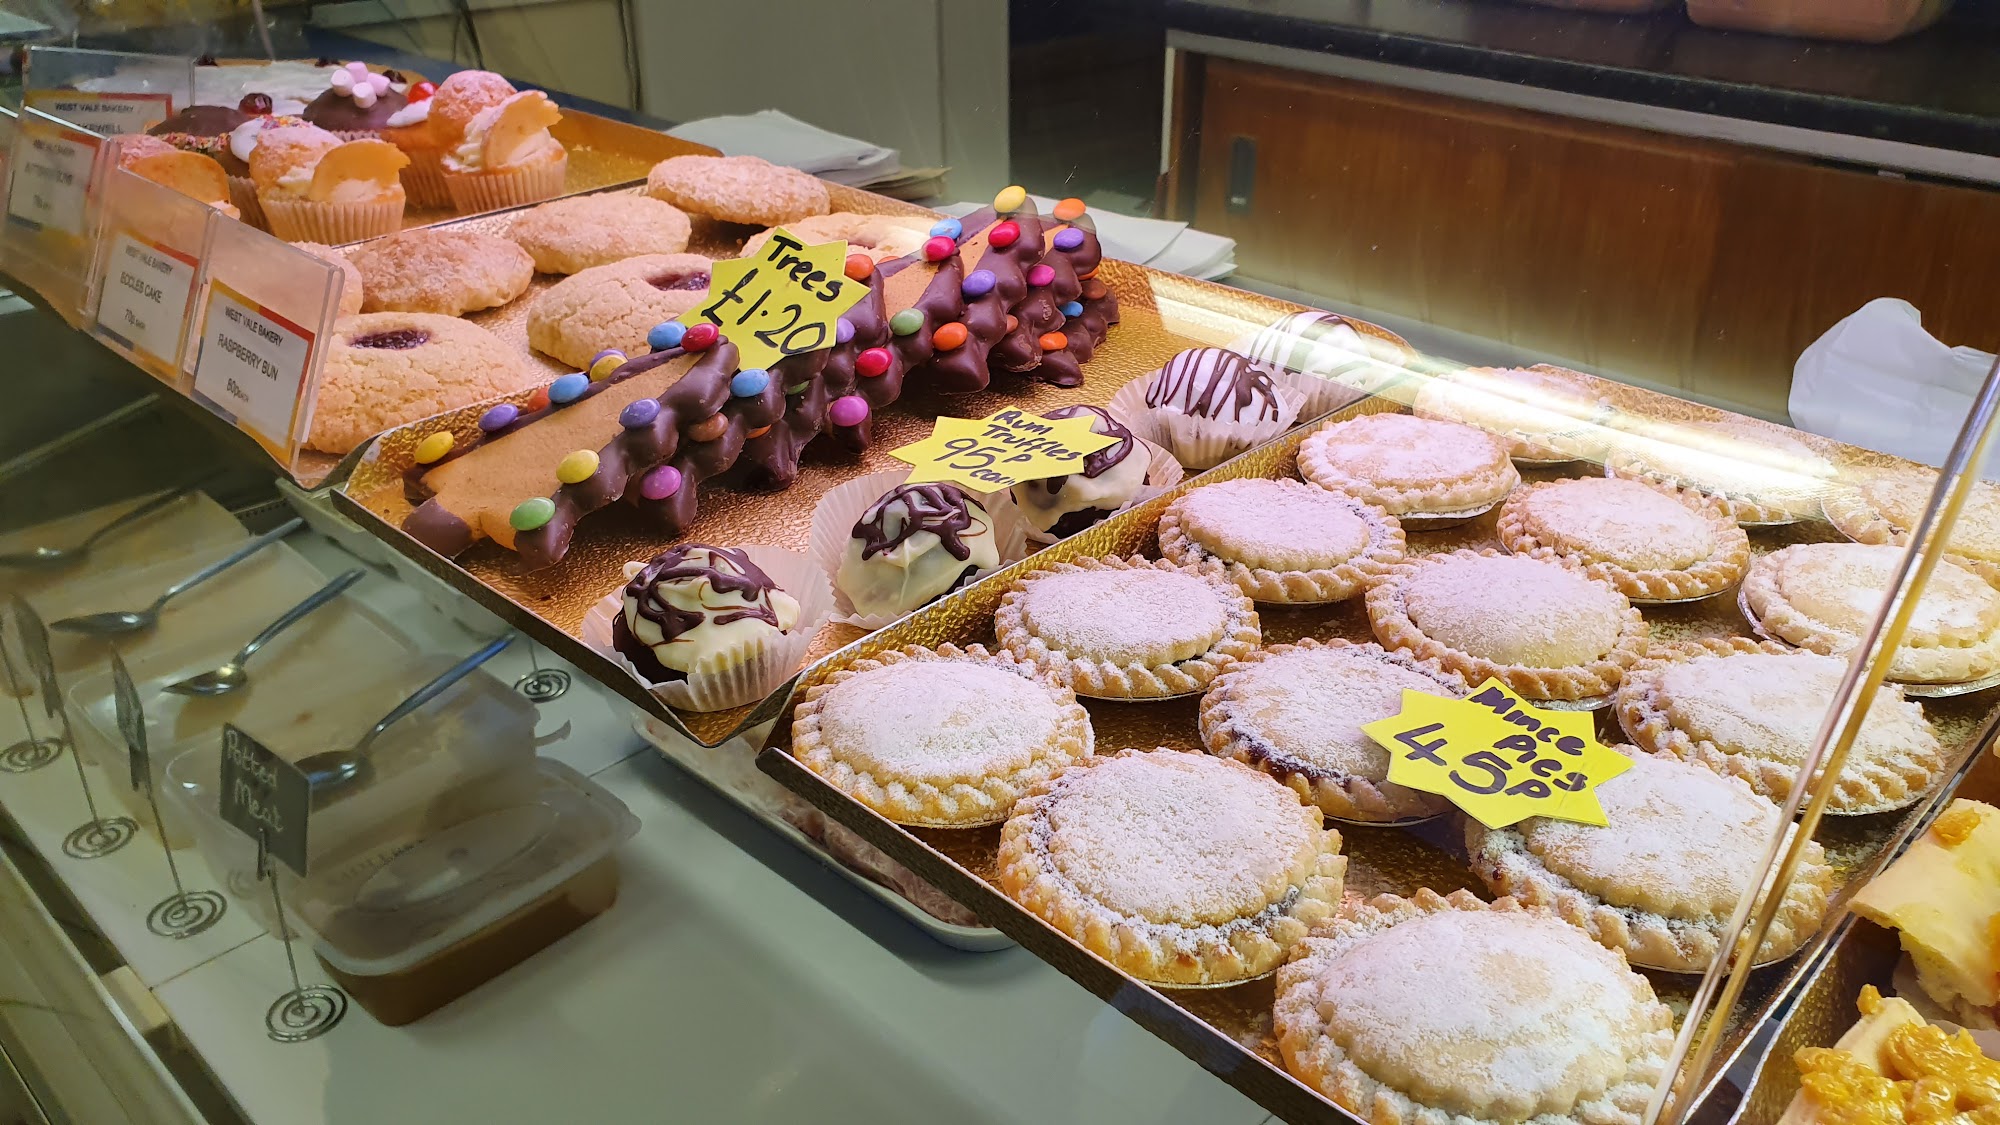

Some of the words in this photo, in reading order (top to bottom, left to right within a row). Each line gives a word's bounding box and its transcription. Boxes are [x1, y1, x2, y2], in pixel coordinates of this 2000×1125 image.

[767, 234, 844, 302] Trees
[144, 284, 163, 305] CAKE
[700, 267, 827, 356] £1.20
[225, 305, 243, 323] WEST
[242, 315, 258, 334] VALE
[258, 324, 284, 347] BAKERY
[217, 333, 263, 371] RASPBERRY
[261, 360, 279, 382] BUN
[981, 423, 1083, 462] Truffles
[992, 409, 1054, 436] Rum
[1468, 685, 1586, 757] Mince
[226, 729, 278, 790] Potted
[234, 778, 284, 833] Meat
